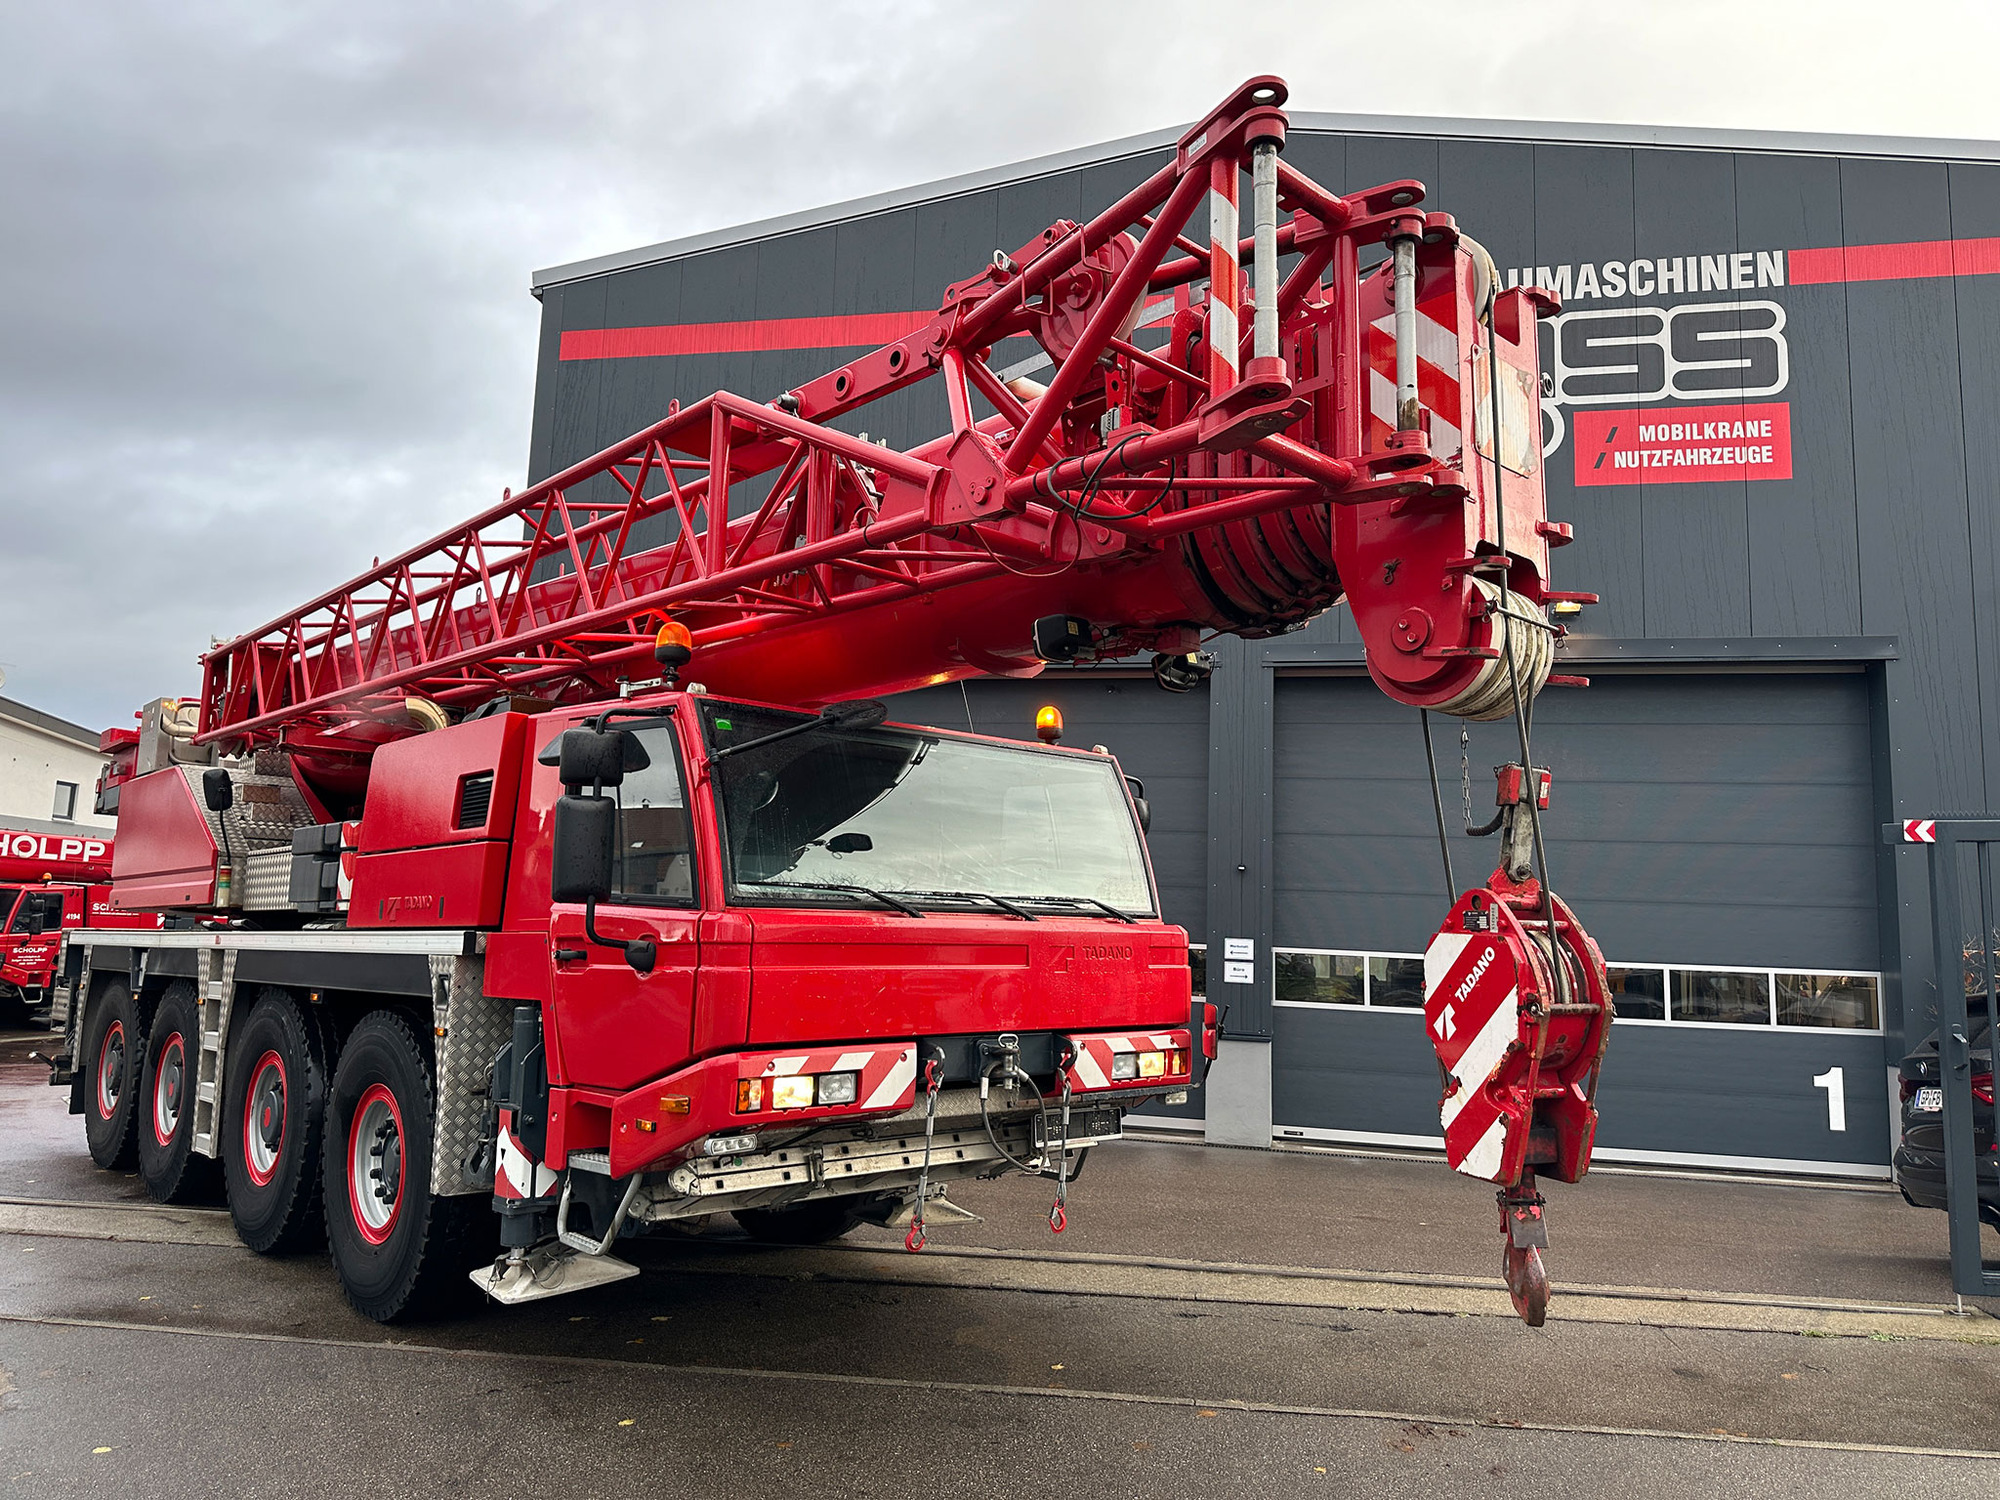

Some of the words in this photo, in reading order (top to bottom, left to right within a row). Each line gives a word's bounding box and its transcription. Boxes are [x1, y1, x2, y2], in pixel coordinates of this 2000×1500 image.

[1638, 420, 1772, 442] MOBILKRANE
[1614, 446, 1773, 468] NUTZFAHRZEUGE
[1082, 945, 1133, 960] TADANO
[1454, 946, 1496, 1003] TADANO
[1813, 1066, 1846, 1131] 1
